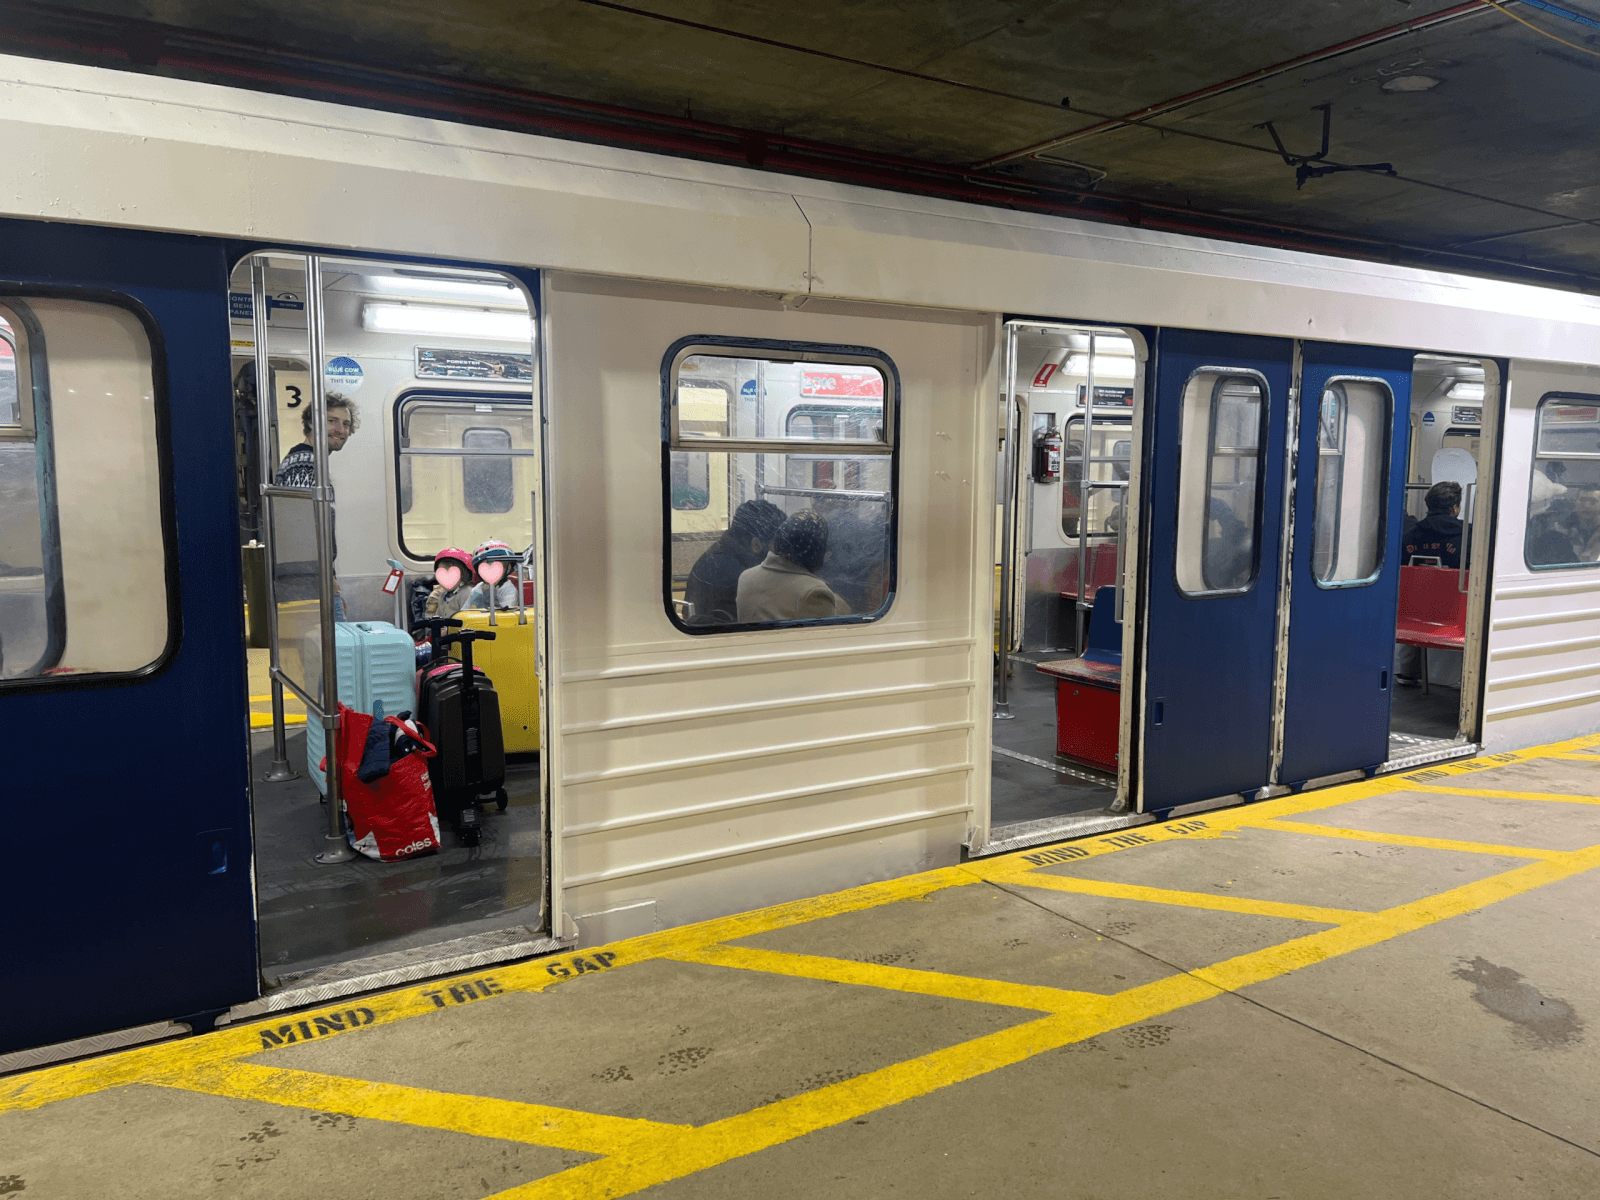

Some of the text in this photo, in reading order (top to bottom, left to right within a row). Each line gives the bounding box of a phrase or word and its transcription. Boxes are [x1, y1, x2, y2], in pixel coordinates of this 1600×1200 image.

[285, 385, 302, 408] 3
[395, 838, 432, 857] coles
[1021, 820, 1210, 867] MIND THE GAP
[260, 952, 616, 1049] MIND THE GAP
